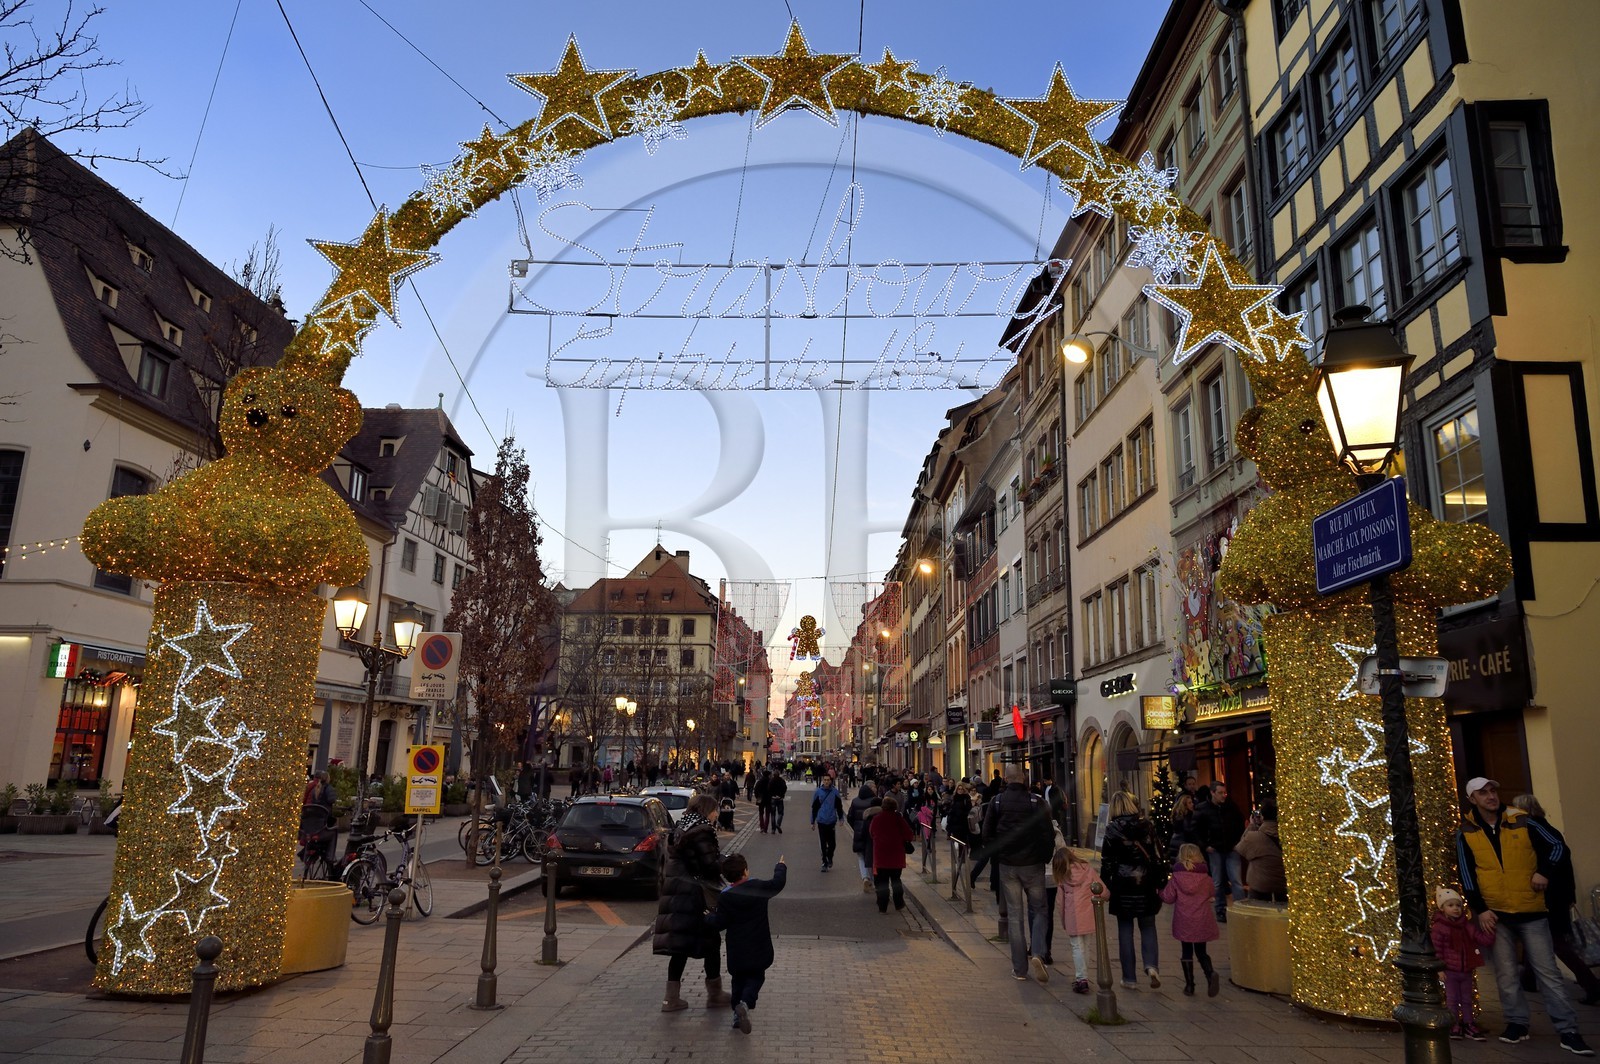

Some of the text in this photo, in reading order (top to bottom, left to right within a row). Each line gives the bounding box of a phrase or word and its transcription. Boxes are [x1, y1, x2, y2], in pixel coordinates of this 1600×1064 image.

[508, 181, 1073, 390] Strasbourg
[545, 321, 763, 417] Capitale
[775, 336, 836, 390] de
[1329, 499, 1376, 534] RUE DU VIEUX
[1317, 514, 1395, 563] MARCHÉ AUX POISSONS
[1332, 560, 1347, 579] Alter
[97, 651, 134, 664] RISTORANTE
[1479, 645, 1512, 677] CAFÉ
[1100, 672, 1136, 699] GEOX
[1146, 710, 1175, 718] Jacques
[1146, 716, 1175, 726] Bockel
[1197, 701, 1220, 717] Jacques
